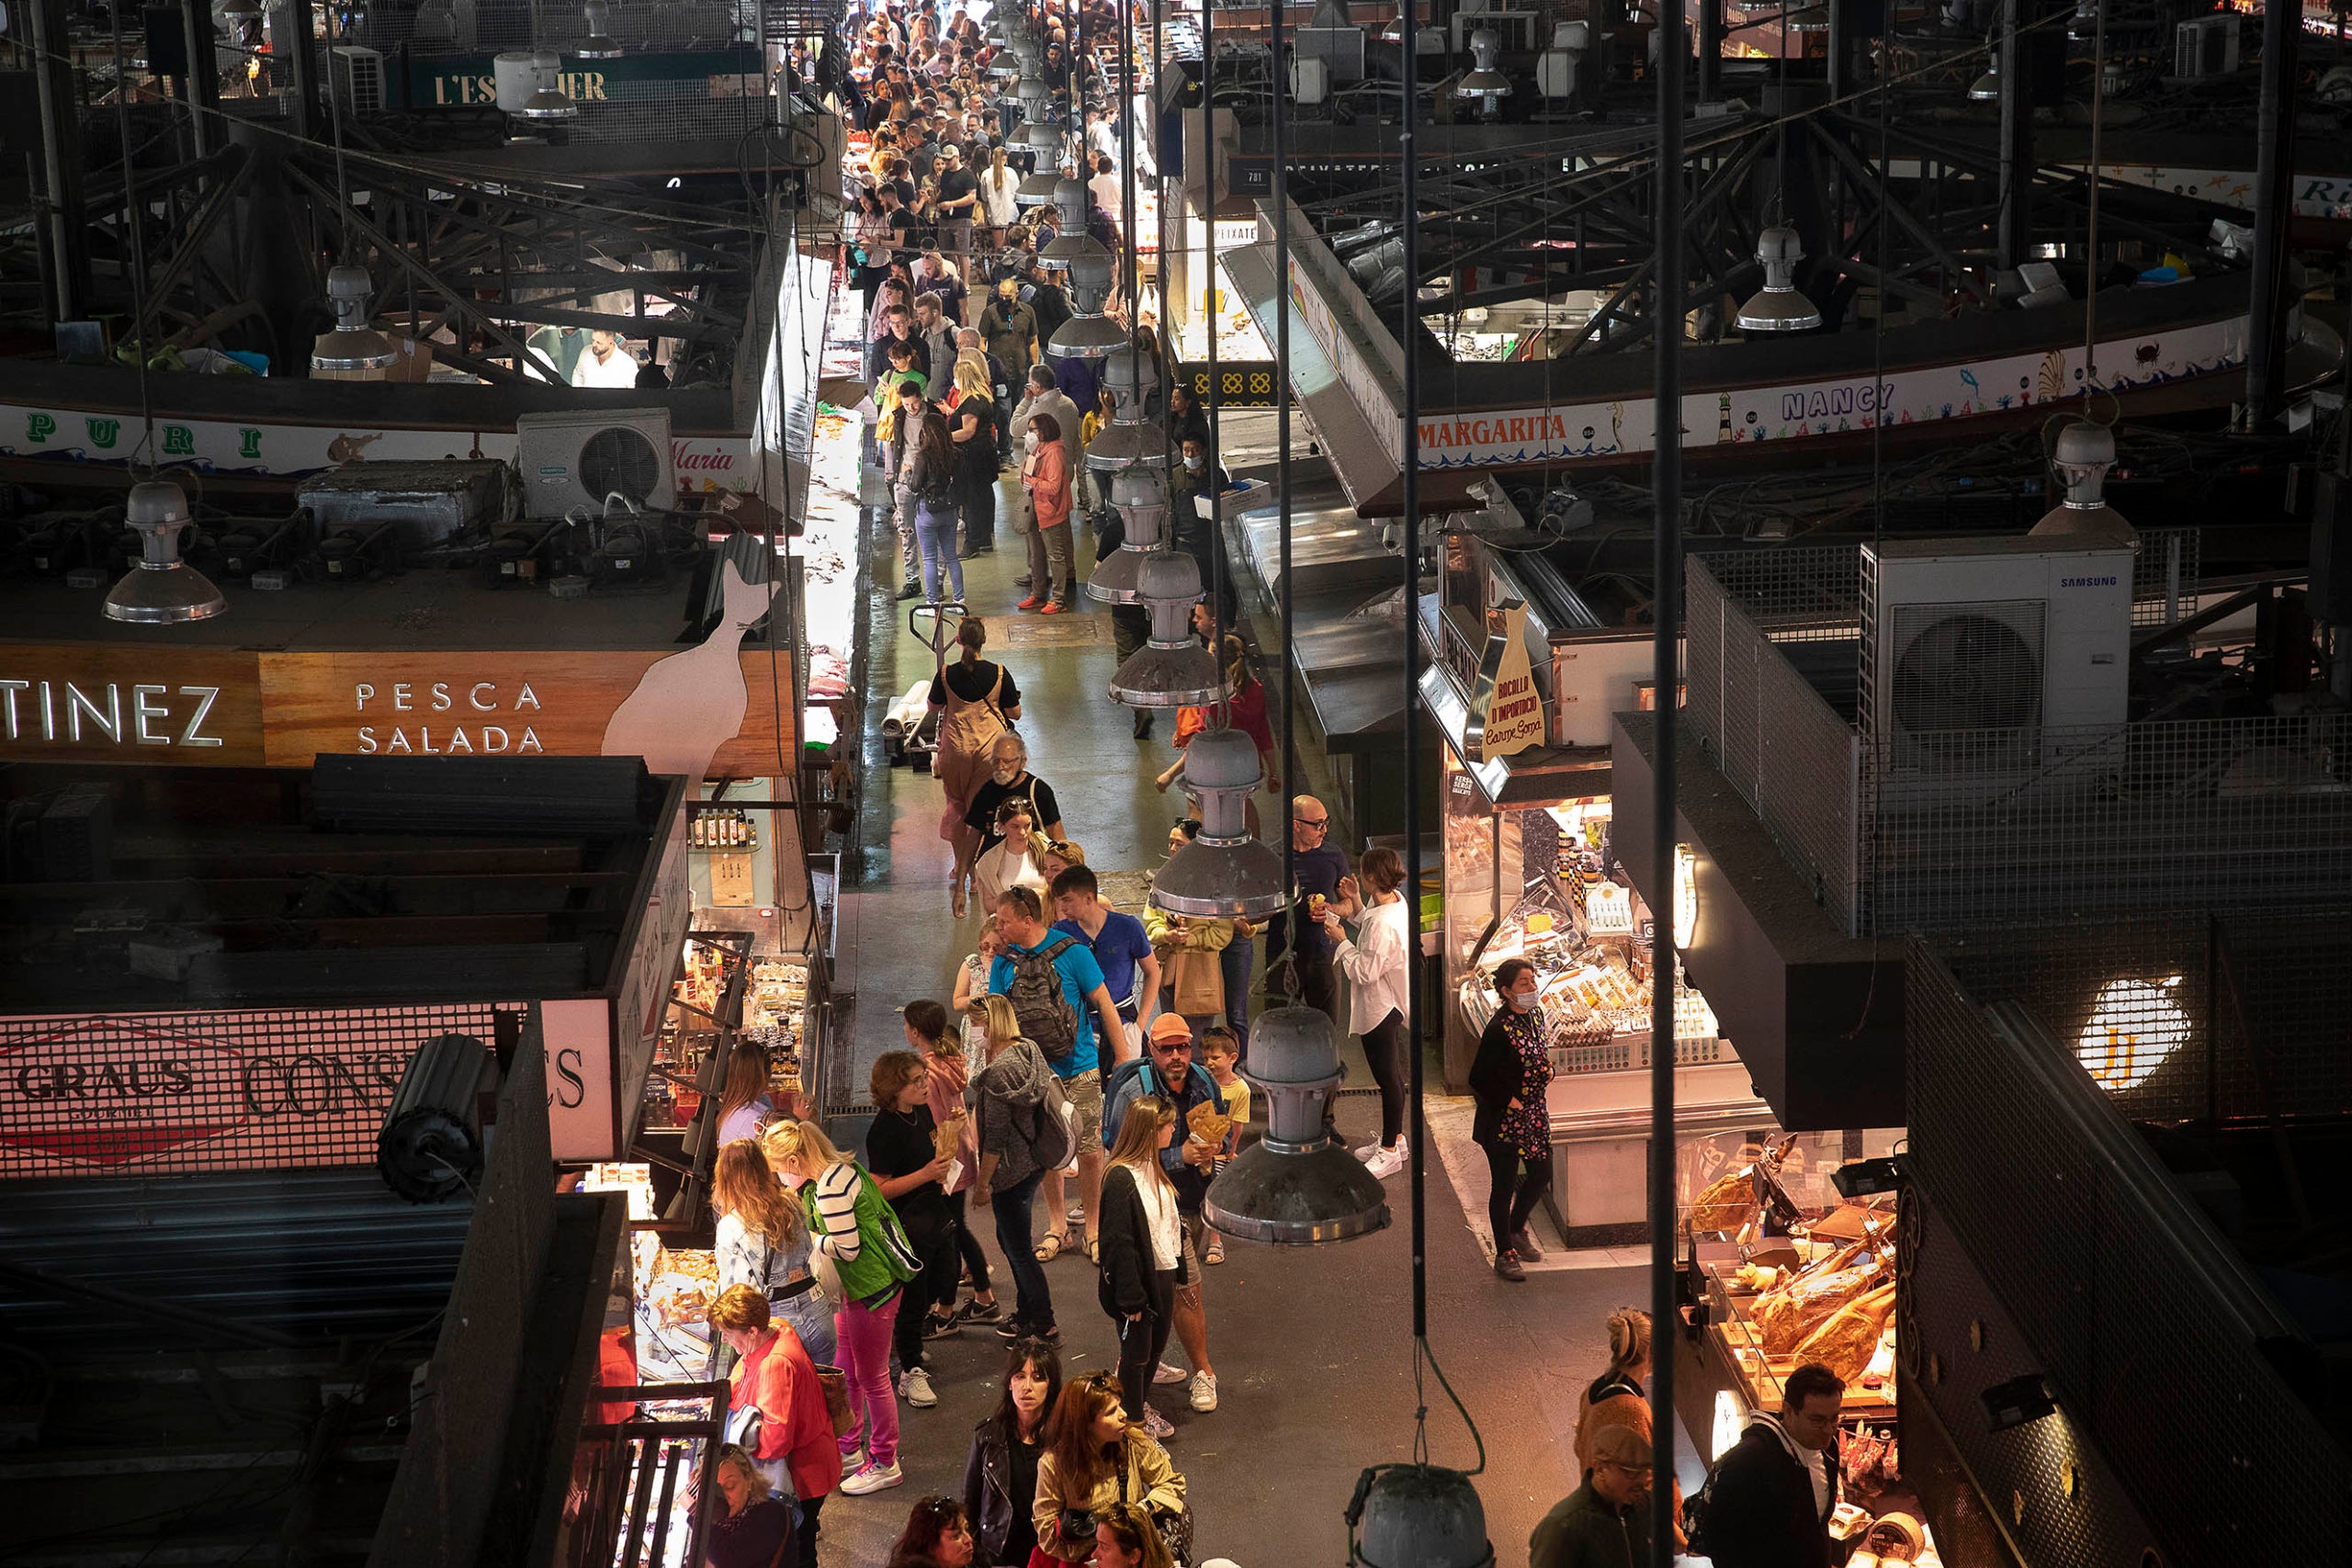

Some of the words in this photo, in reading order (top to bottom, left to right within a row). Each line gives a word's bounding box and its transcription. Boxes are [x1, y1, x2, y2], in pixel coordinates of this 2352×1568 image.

[1782, 384, 1894, 422] NANCY
[27, 413, 264, 458] PURI
[1418, 414, 1566, 449] MARGARITA
[2061, 577, 2117, 588] SAMSUNG
[356, 682, 541, 711] PESCA
[0, 680, 223, 747] TINEZ
[357, 726, 544, 755] SALADA
[1486, 728, 1517, 745] Carme
[17, 1061, 191, 1099] GRAUS
[70, 1107, 153, 1120] GOURMET
